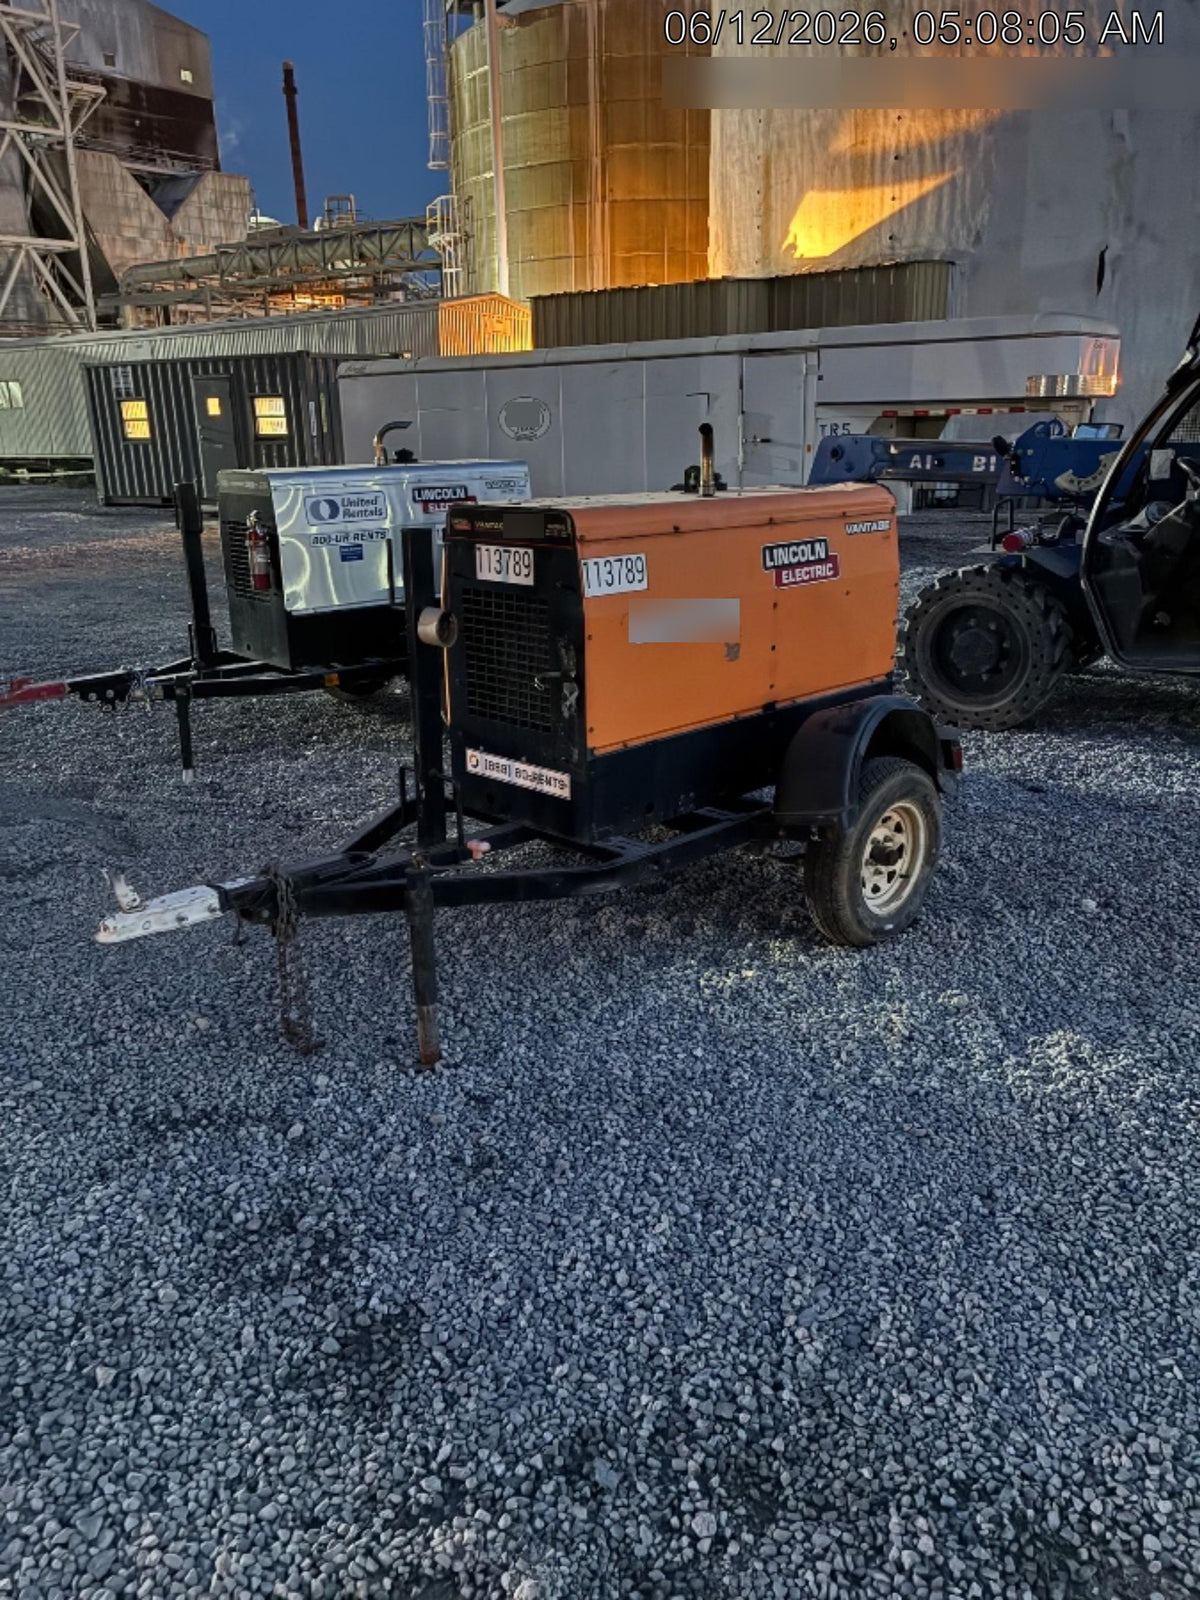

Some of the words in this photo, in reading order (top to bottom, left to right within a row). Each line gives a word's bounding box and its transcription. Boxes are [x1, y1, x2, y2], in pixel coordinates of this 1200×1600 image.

[341, 496, 378, 508] United
[414, 487, 467, 500] LINCOLN
[342, 507, 384, 519] Rentals
[477, 546, 532, 578] 113789
[765, 541, 826, 568] LINCOLN
[582, 556, 645, 589] 113789
[782, 563, 834, 584] ELECTRIC
